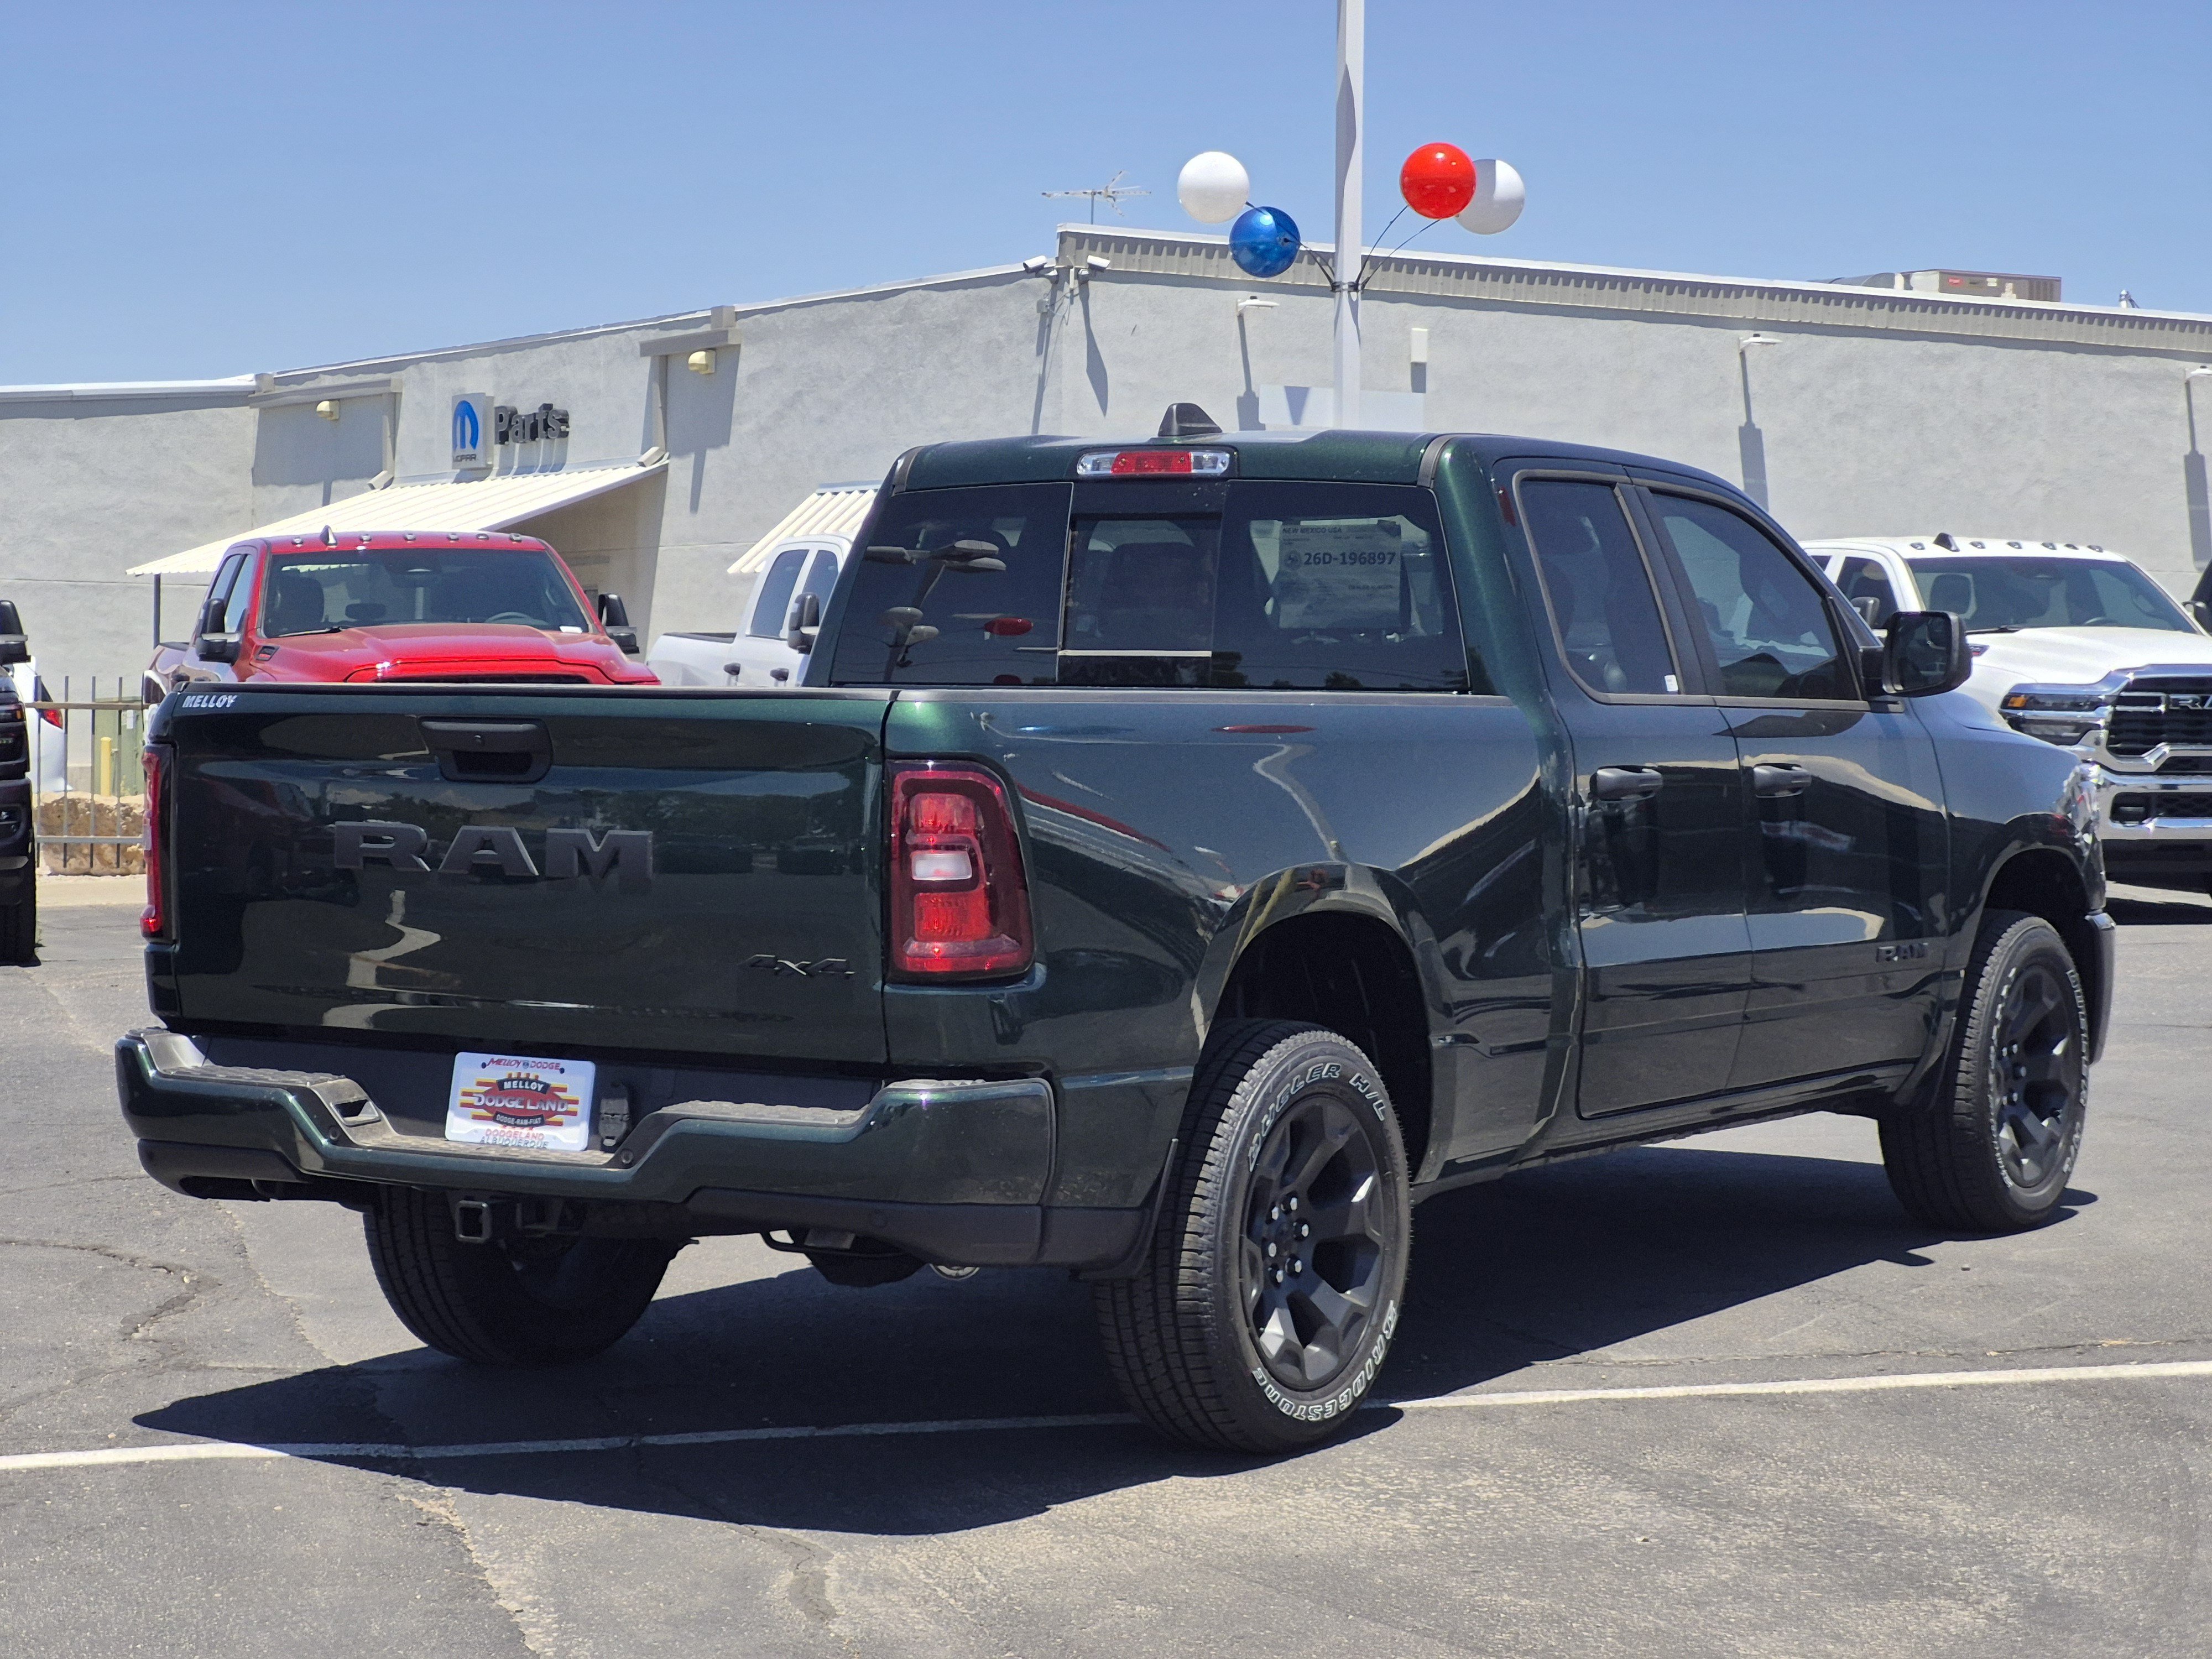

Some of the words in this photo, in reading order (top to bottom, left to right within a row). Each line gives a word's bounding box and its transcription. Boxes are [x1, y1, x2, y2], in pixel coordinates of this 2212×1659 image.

[494, 403, 569, 445] Parts
[1303, 552, 1396, 565] 26D-196897
[182, 695, 238, 708] MELLOY
[333, 820, 654, 880] RAM
[1876, 942, 1929, 963] RAM
[487, 1058, 521, 1068] MELLOY
[530, 1061, 560, 1071] DODGE
[503, 1081, 544, 1092] MELLOY
[485, 1128, 544, 1141] DODGELAND
[480, 1135, 549, 1149] ALBUQUERQUE
[1251, 1300, 1397, 1422] BRIDGESTONE
